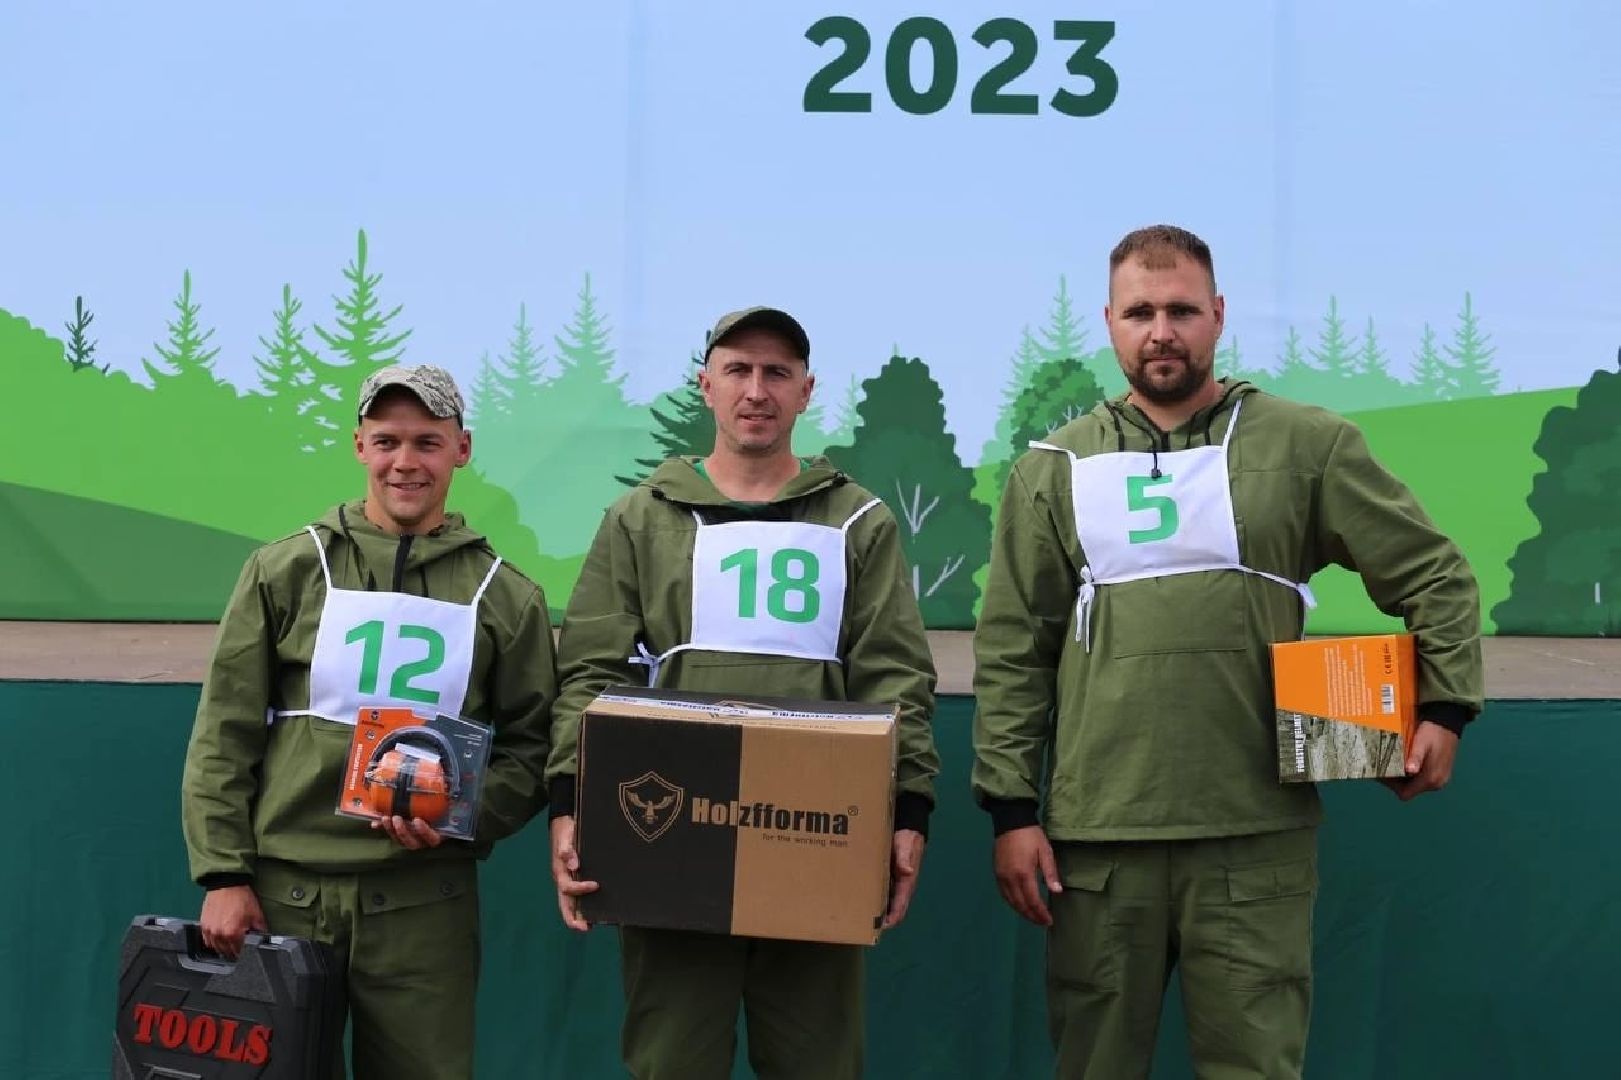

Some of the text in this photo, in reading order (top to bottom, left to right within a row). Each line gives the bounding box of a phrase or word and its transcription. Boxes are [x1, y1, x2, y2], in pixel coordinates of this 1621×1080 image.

[803, 16, 1119, 117] 2023
[1126, 474, 1180, 545] 5
[720, 548, 821, 624] 18
[345, 620, 445, 704] 12
[133, 1003, 273, 1065] TOOLS
